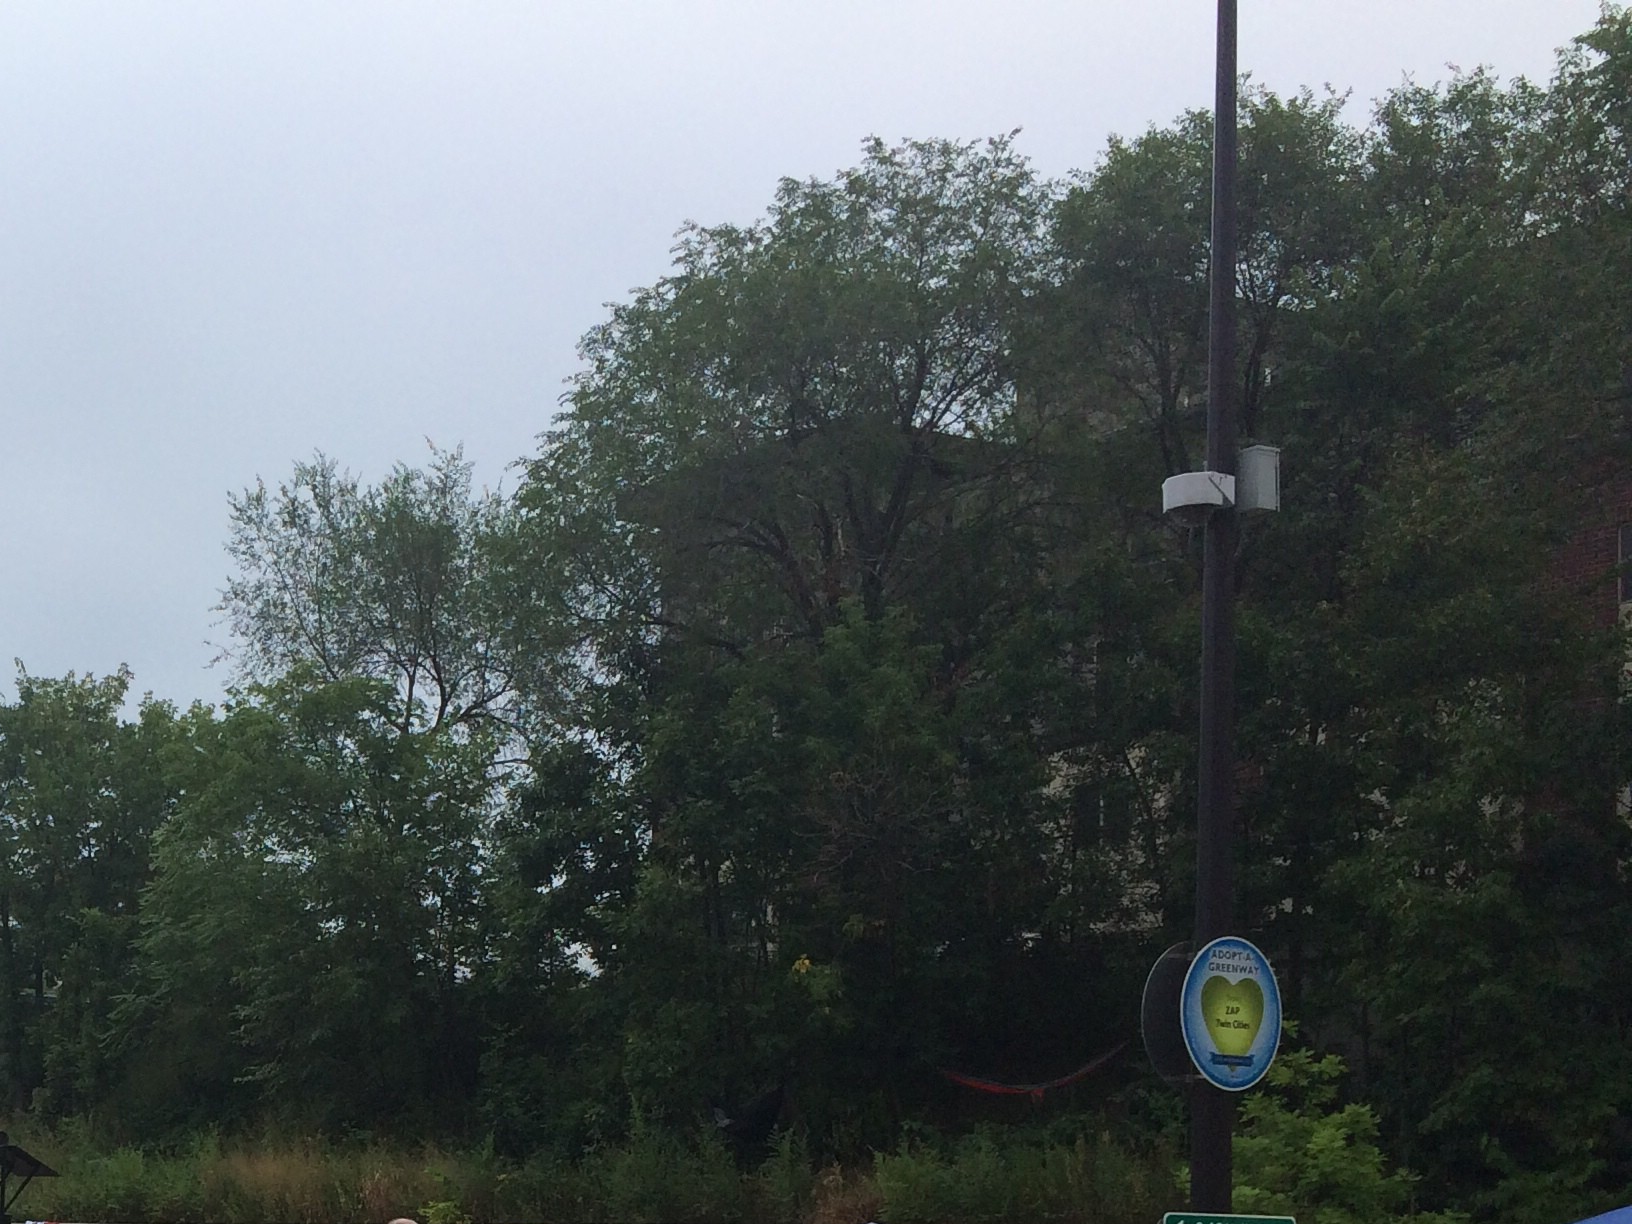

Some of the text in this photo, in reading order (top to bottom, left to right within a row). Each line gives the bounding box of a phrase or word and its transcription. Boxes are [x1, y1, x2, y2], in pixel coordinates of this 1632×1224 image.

[1208, 962, 1259, 976] GREENWAY
[1225, 1005, 1241, 1015] ZAP
[1215, 1018, 1232, 1028] Twin
